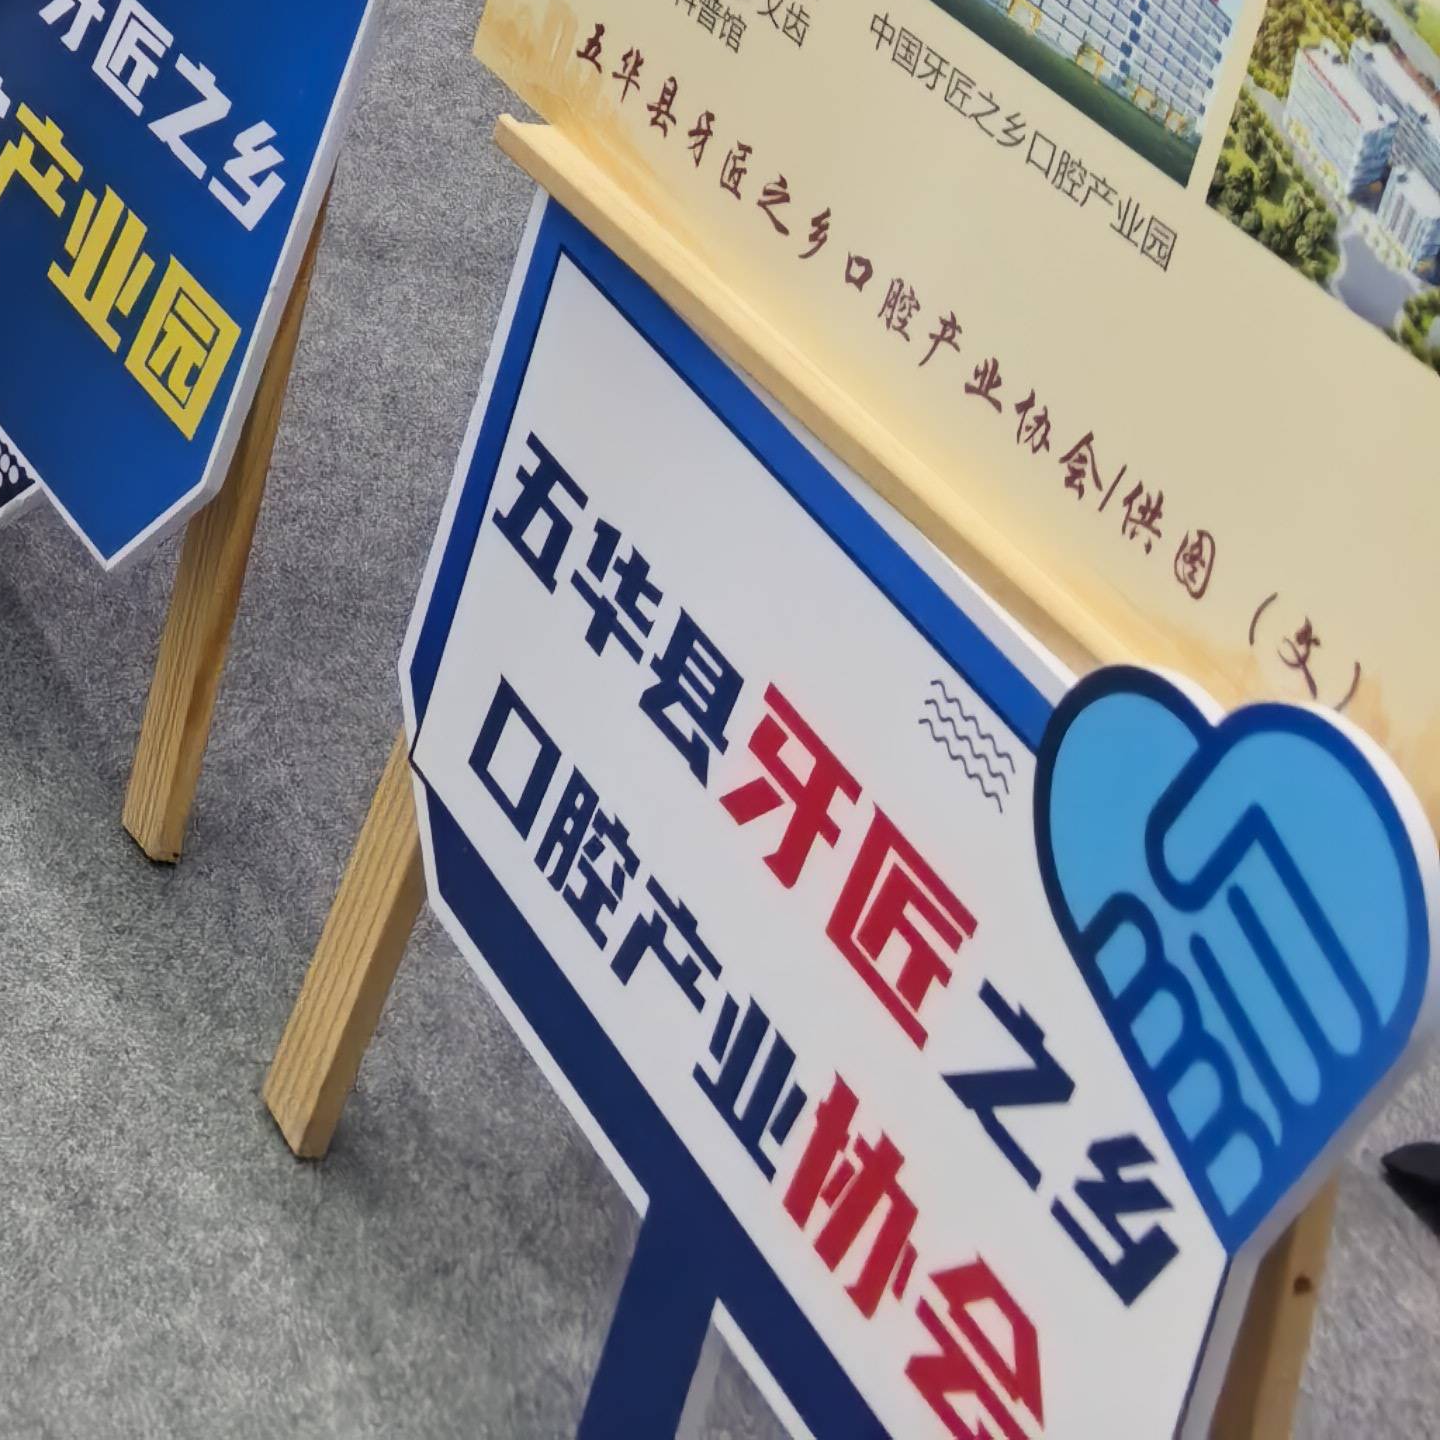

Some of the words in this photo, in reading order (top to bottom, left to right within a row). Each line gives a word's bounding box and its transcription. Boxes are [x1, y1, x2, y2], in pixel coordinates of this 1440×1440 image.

[869, 12, 1179, 272] 中国牙匠之乡口腔产业园
[468, 675, 1047, 1440] 口腔产业协会
[491, 432, 1182, 1306] 五华县牙匠之乡
